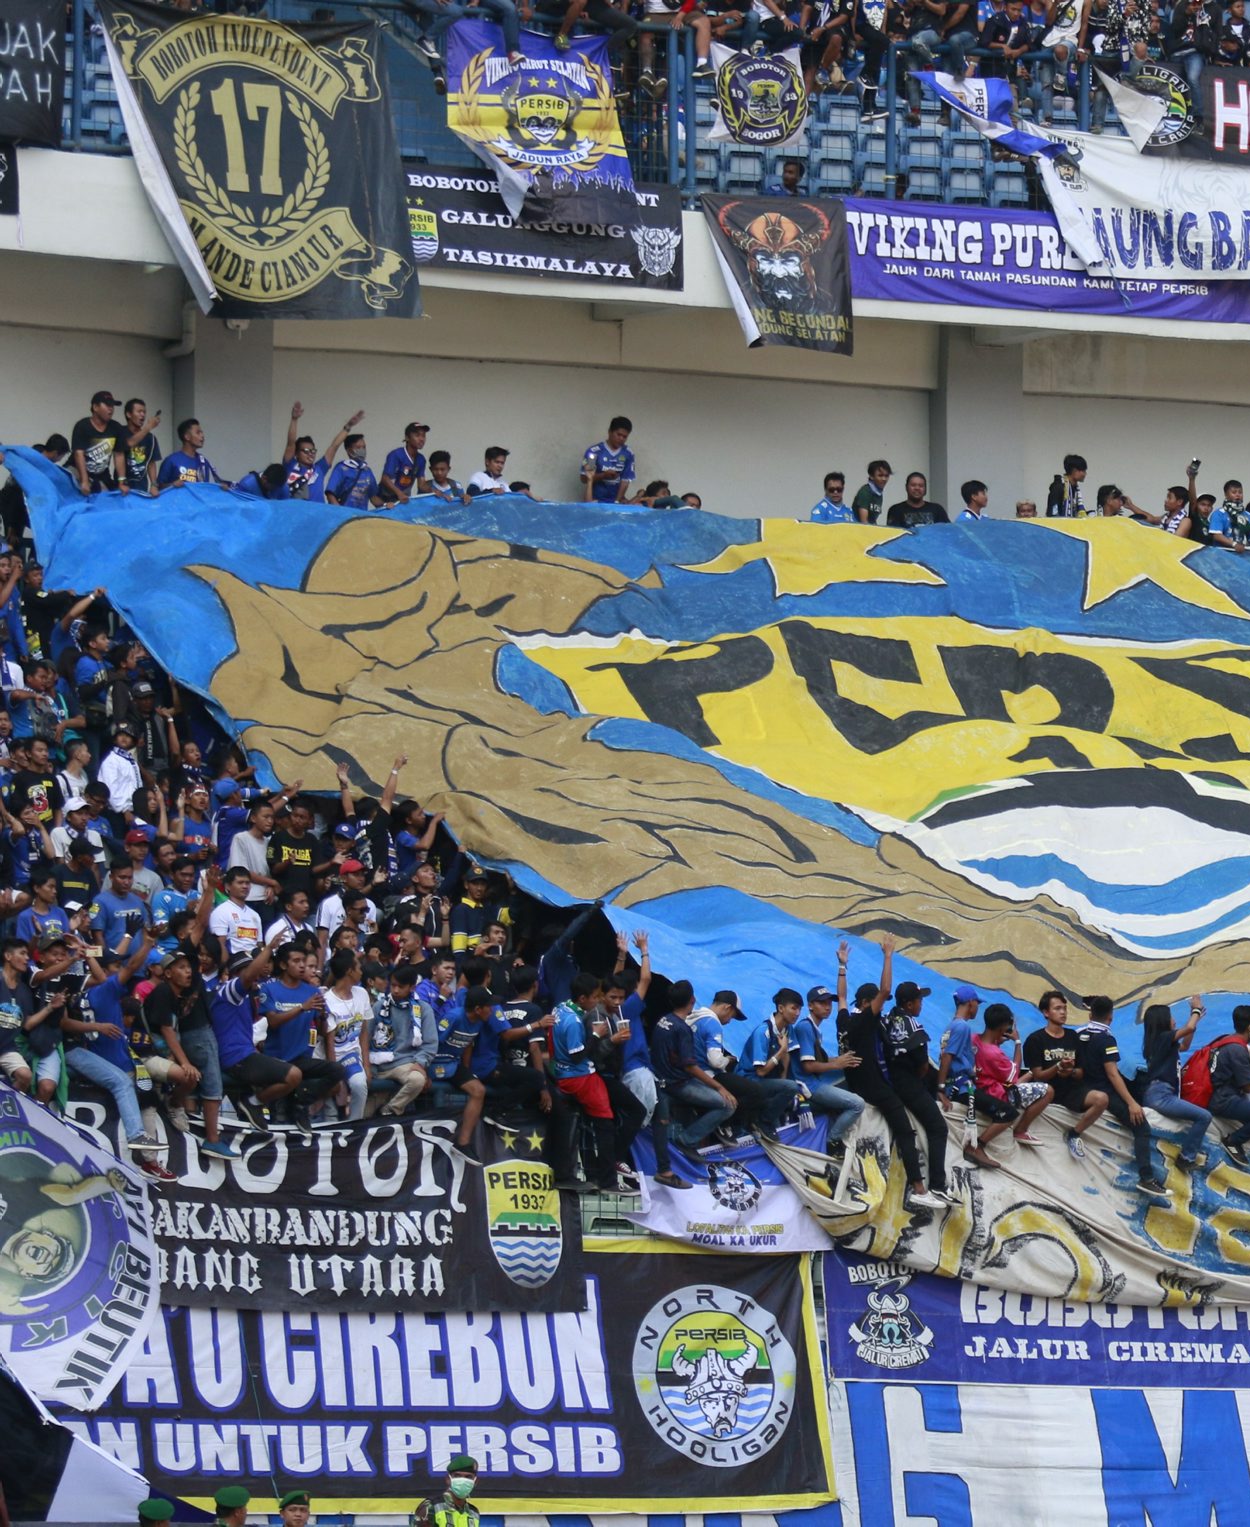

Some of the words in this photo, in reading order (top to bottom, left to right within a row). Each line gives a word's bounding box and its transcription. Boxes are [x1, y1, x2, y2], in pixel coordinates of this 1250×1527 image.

[222, 24, 332, 97] INDEPENDENT
[550, 58, 591, 91] SELATAN
[741, 62, 787, 78] BOBOTOH
[0, 69, 52, 108] AH
[520, 98, 565, 110] PERSIB
[730, 88, 744, 99] 19
[210, 77, 284, 196] 17
[742, 129, 781, 141] BOGOR
[511, 151, 553, 164] JADUN
[556, 152, 584, 165] RAYA
[408, 174, 501, 194] BOBOTOH
[441, 209, 627, 238] GALUNGGUNG
[846, 211, 984, 264] VIKING
[260, 223, 344, 293] CIANJUR
[442, 247, 634, 279] TASIKMALAYA
[883, 263, 918, 278] JAUH
[923, 267, 955, 280] DARI
[960, 270, 1001, 283] TANAH
[1006, 273, 1077, 288] PASUNDAN
[1083, 278, 1115, 291] KAMI
[1120, 280, 1158, 295] TETAP
[1161, 282, 1210, 297] PERSIB
[691, 1233, 726, 1247] MOAL
[729, 1234, 746, 1247] KA
[749, 1234, 777, 1246] UKUR
[287, 1252, 446, 1298] UTARA
[54, 1240, 152, 1402] BEUTIK
[640, 1289, 782, 1351] NORTH
[675, 1328, 748, 1343] PERSIB
[261, 1275, 614, 1414] CIREBON
[964, 1336, 1091, 1364] JALUR
[648, 1400, 789, 1463] HOOLIGAN
[153, 1420, 374, 1478] UNTUK
[383, 1420, 624, 1478] PERSIB
